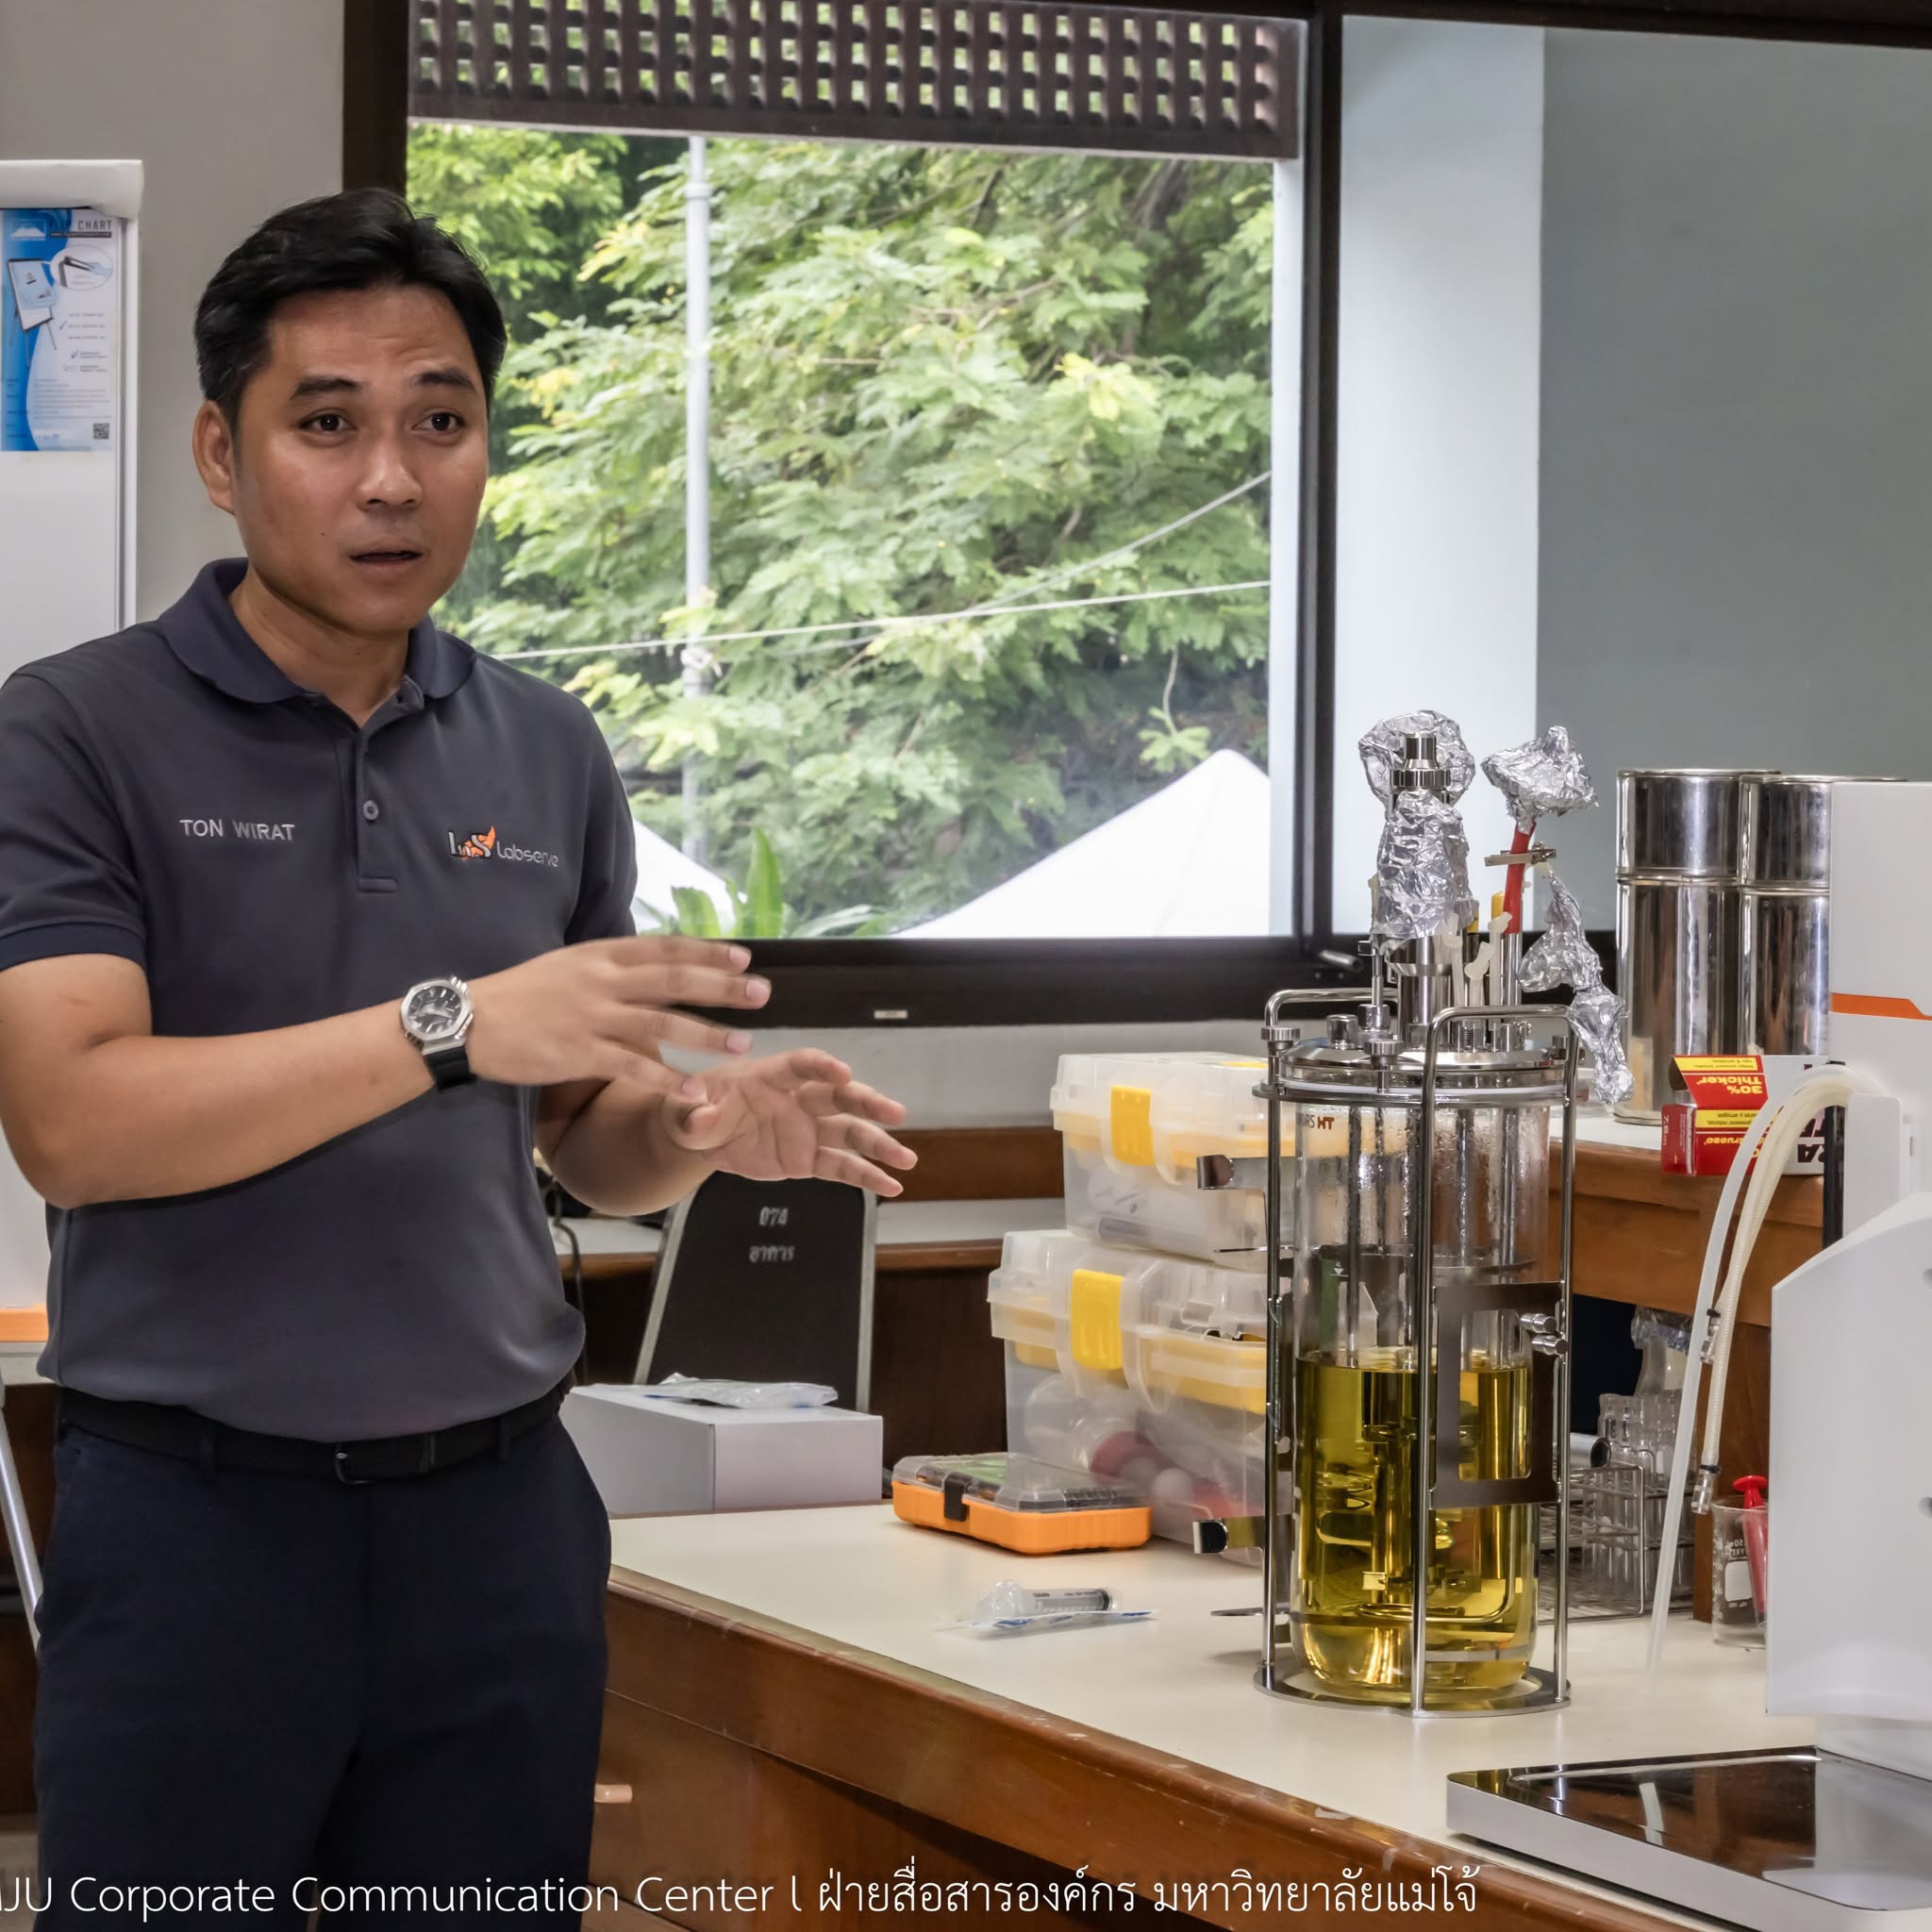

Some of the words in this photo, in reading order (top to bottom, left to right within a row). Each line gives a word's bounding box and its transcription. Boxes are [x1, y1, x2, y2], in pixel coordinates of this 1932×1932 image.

[77, 220, 112, 231] CHART
[179, 818, 224, 838] TON
[232, 820, 295, 841] WIRAT
[1725, 1085, 1763, 1094] 30%
[1317, 1116, 1335, 1130] HT
[758, 1206, 790, 1226] 074
